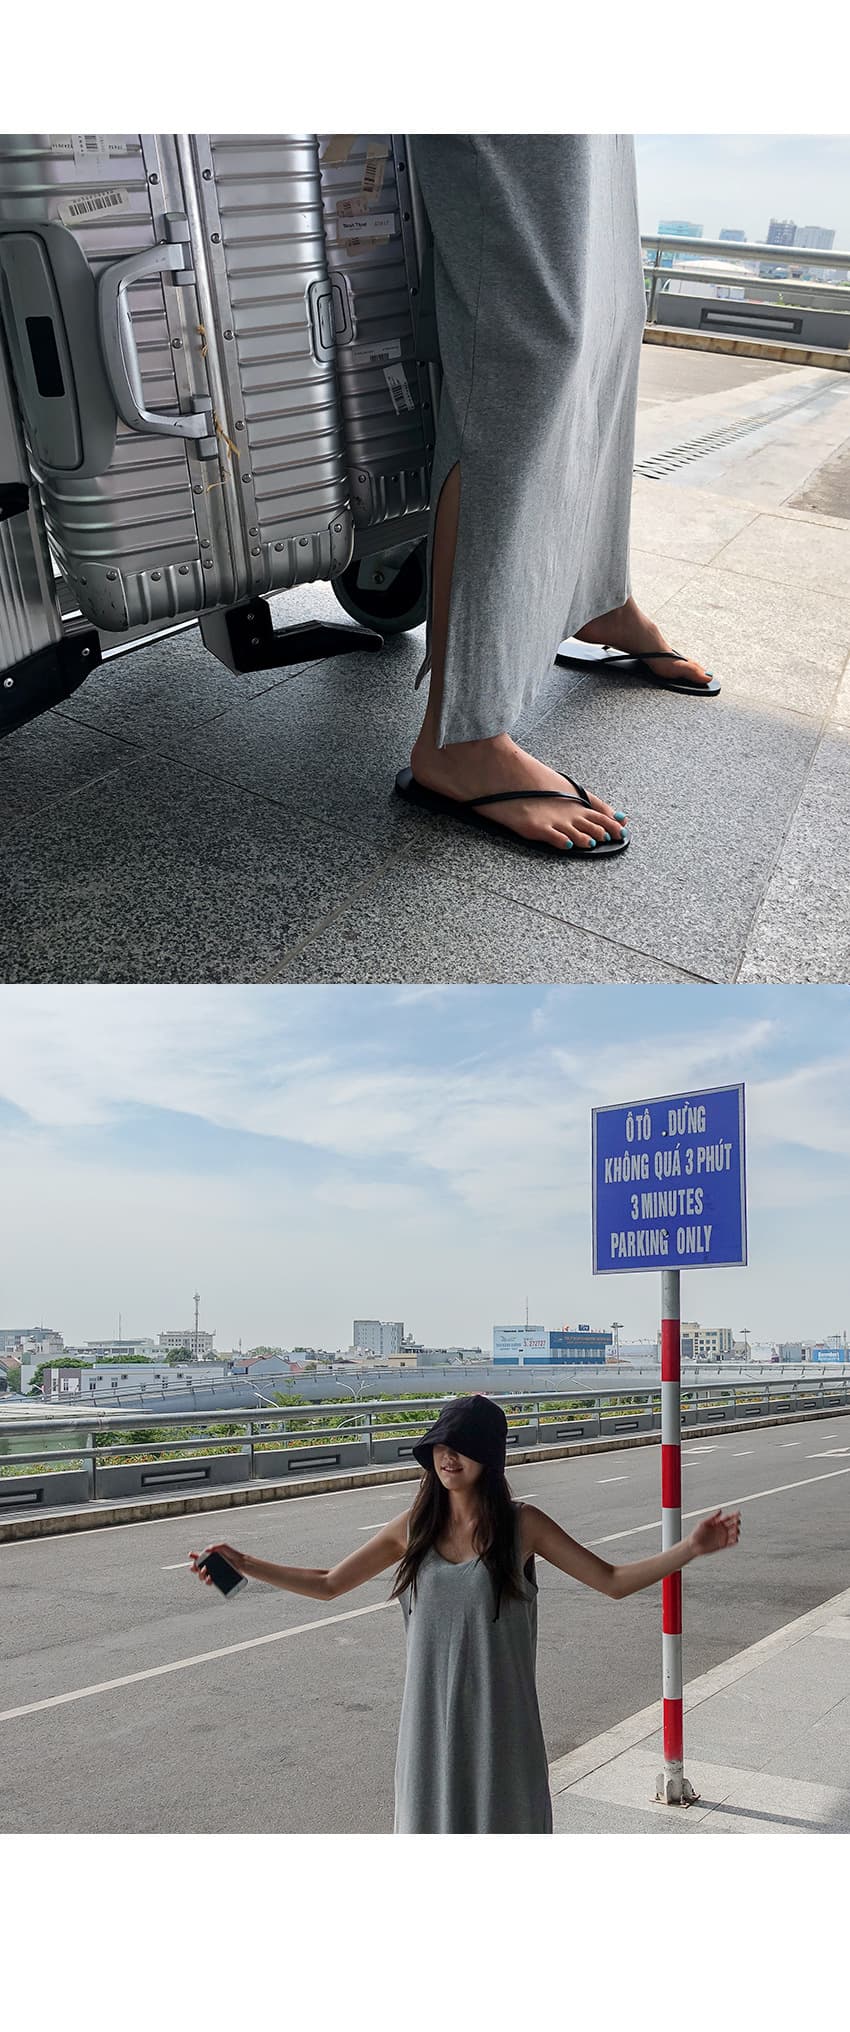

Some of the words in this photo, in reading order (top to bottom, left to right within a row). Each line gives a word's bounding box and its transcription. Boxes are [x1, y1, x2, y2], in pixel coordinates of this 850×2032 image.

[668, 1101, 705, 1136] DỪNG
[604, 1150, 650, 1184] KHÔNG
[654, 1143, 681, 1181] QUÁ
[685, 1148, 694, 1176] 3
[697, 1138, 733, 1174] PHÚT
[631, 1194, 639, 1220] 3
[641, 1187, 704, 1220] MINUTES
[610, 1228, 670, 1259] PARKING
[676, 1225, 713, 1255] ONLY
